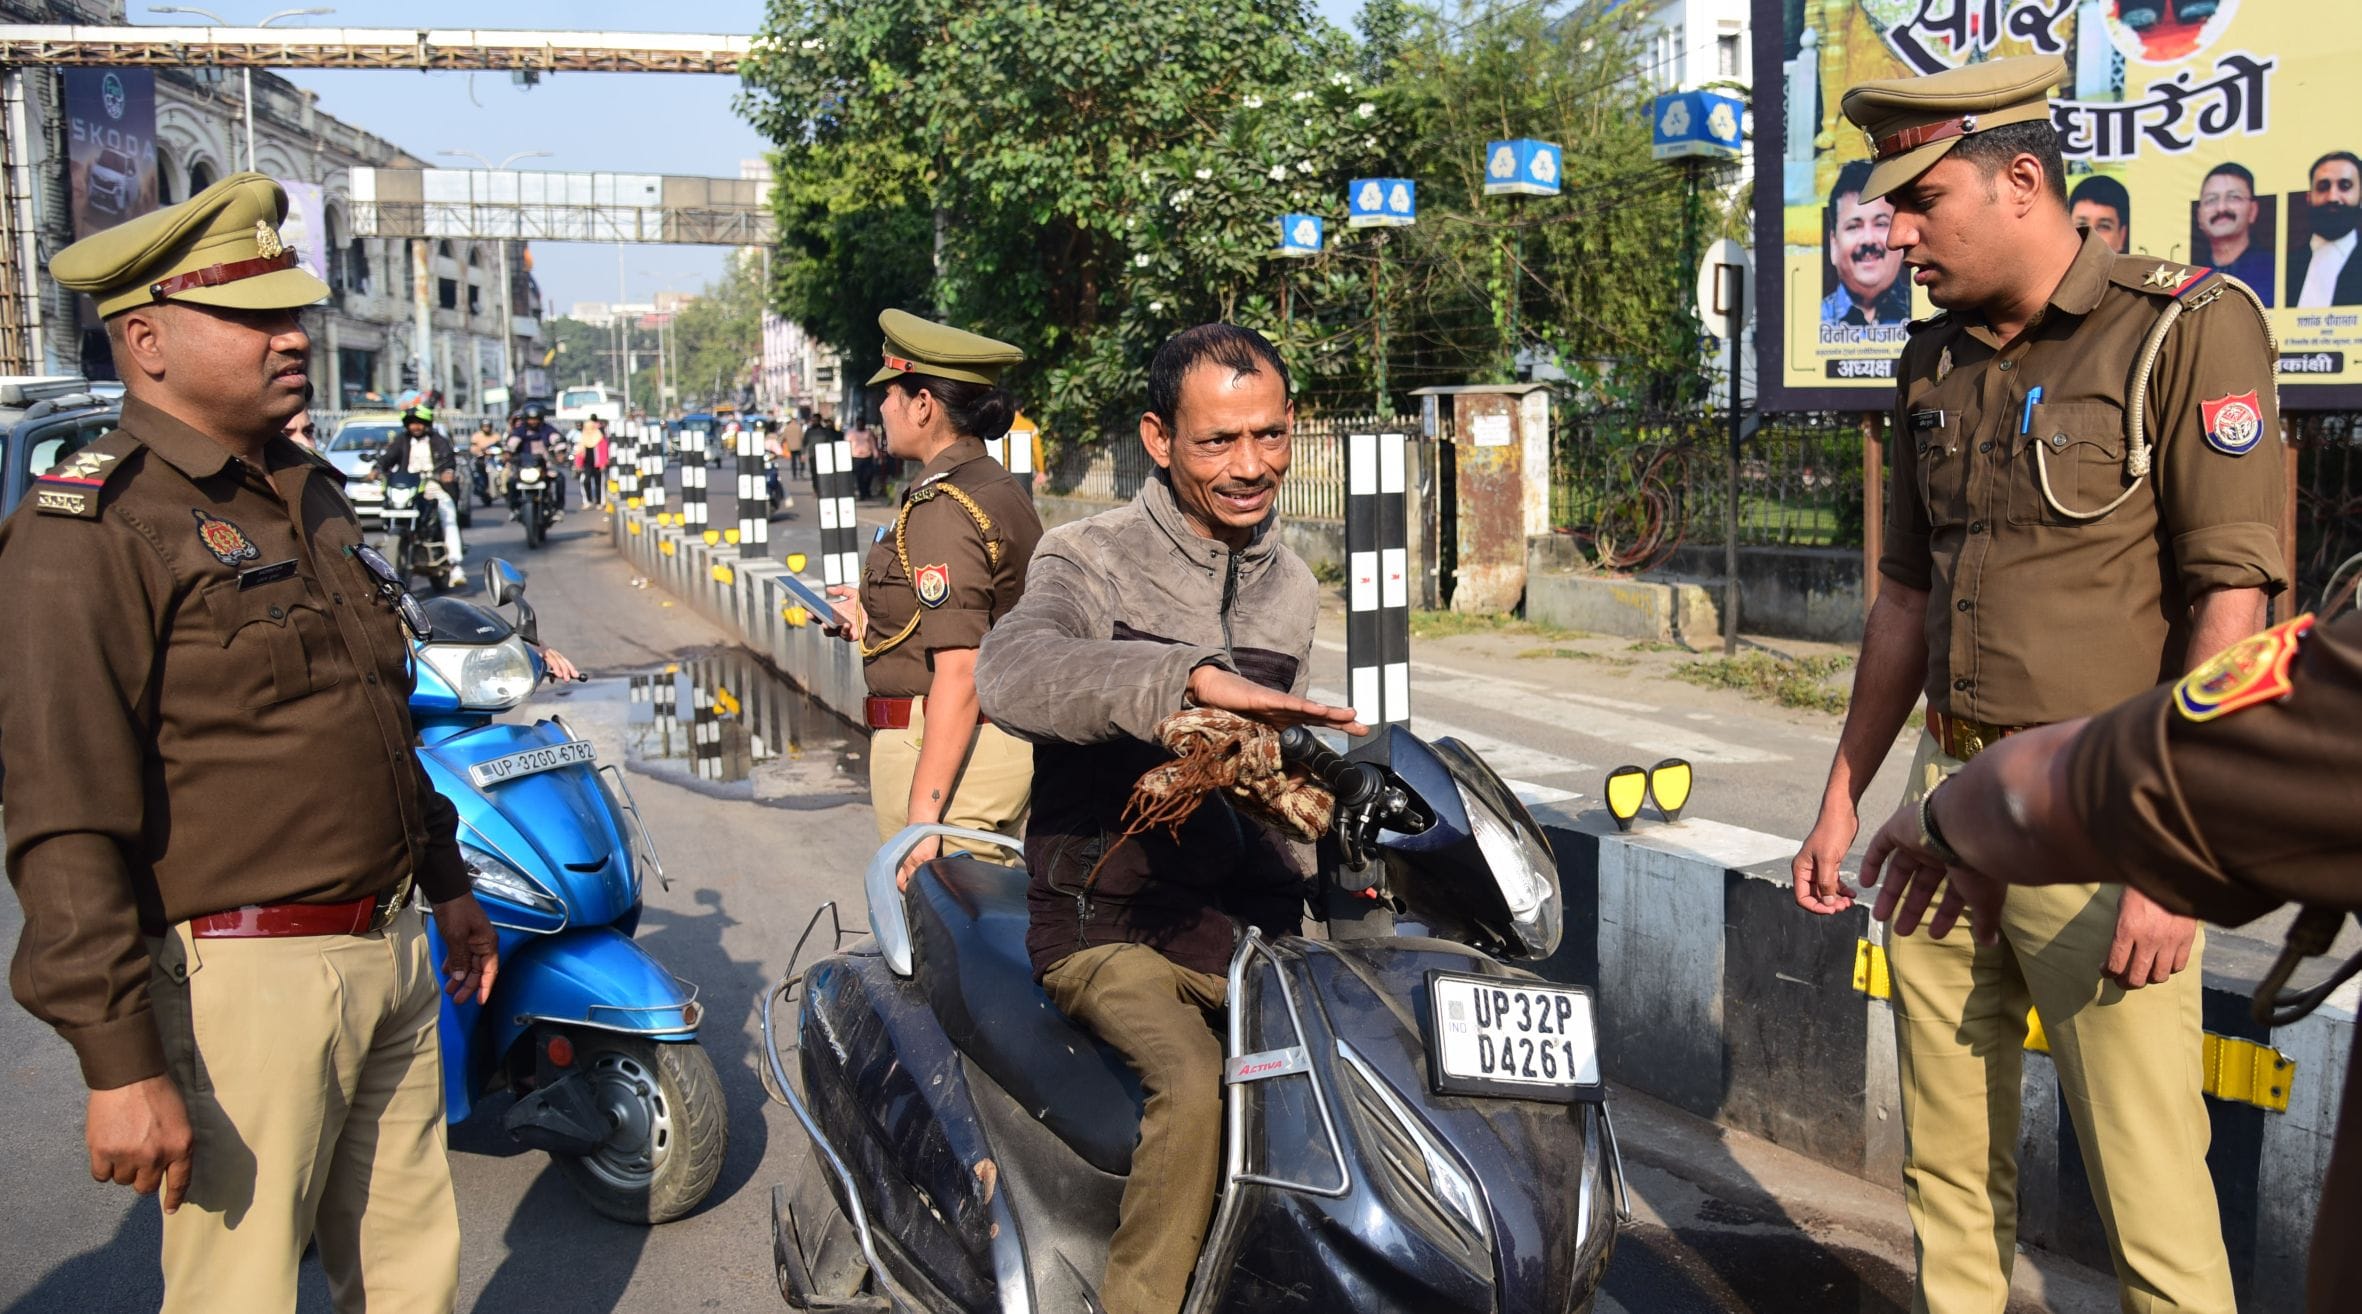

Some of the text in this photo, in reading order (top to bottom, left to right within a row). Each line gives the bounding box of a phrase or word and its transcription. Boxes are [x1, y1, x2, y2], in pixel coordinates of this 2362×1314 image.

[1819, 322, 1860, 344] विनोद
[1837, 360, 1892, 378] अध्यक्ष
[492, 760, 513, 777] UP
[559, 743, 594, 761] 6782
[1474, 987, 1572, 1034] UP32P
[1478, 1034, 1576, 1080] D4261
